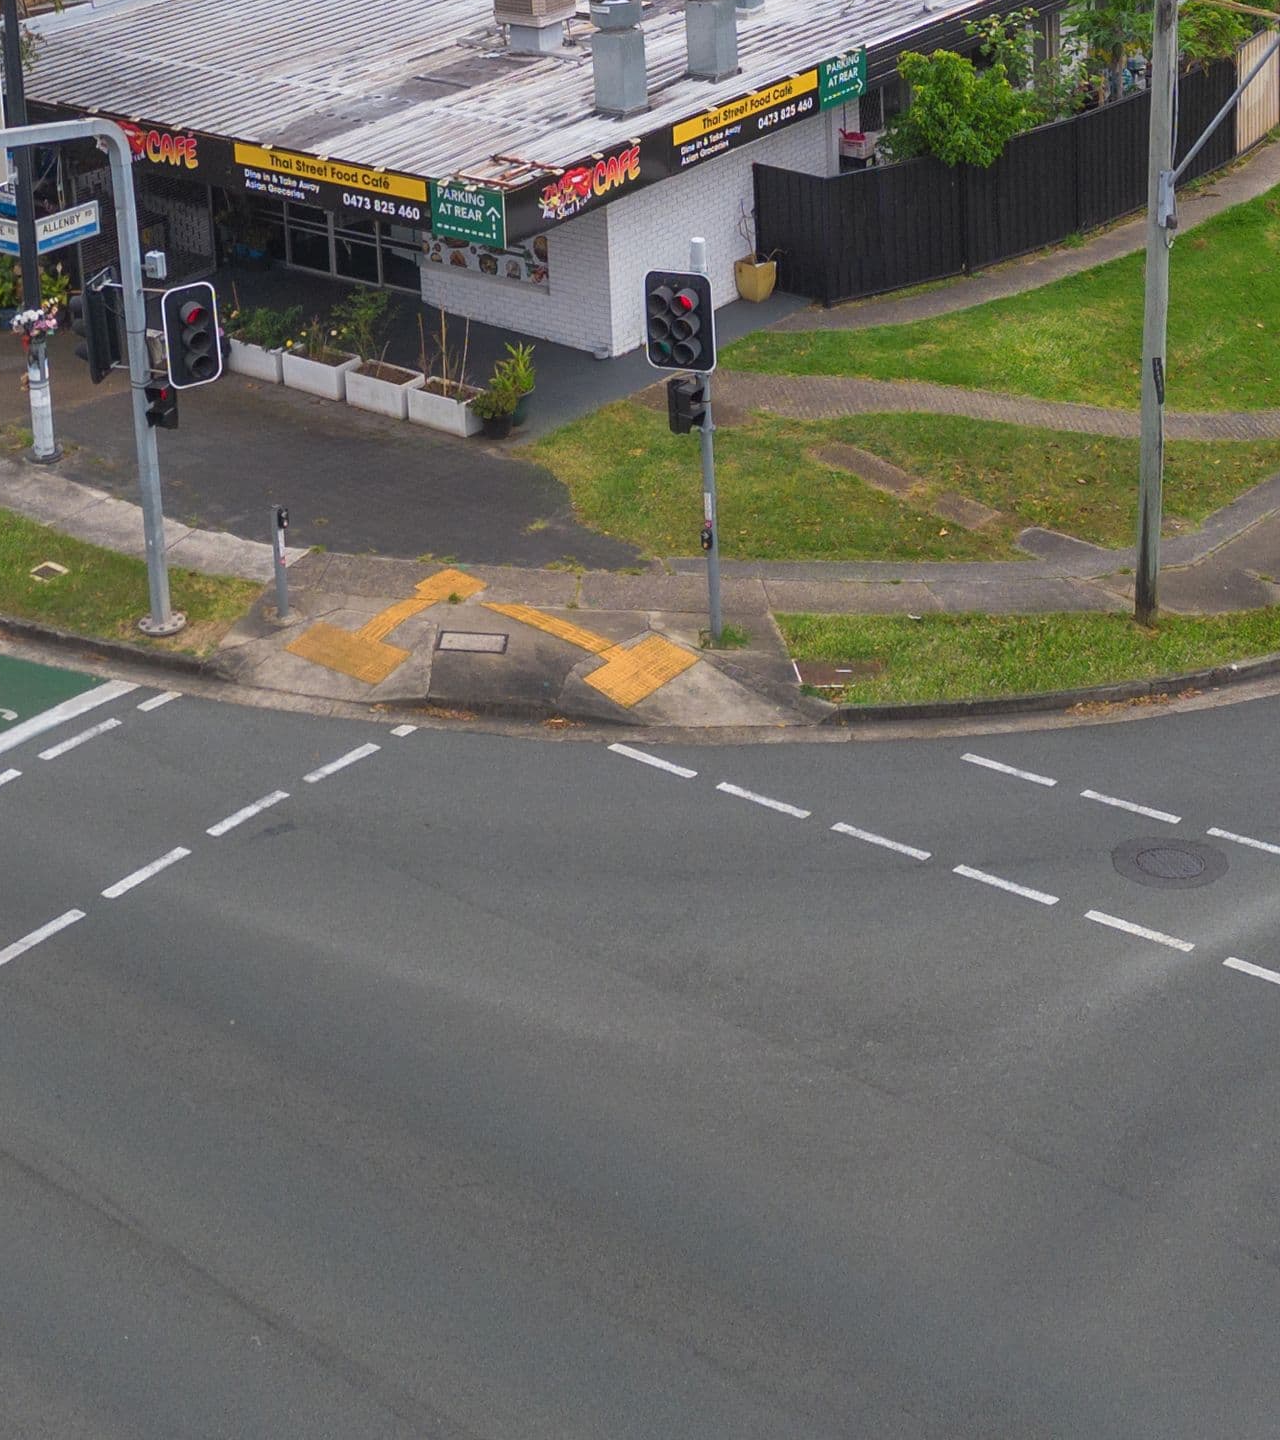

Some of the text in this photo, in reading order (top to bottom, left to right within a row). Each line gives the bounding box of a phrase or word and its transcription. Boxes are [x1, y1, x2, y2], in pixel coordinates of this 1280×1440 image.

[826, 53, 860, 75] PARKING
[828, 67, 859, 88] AT REAR
[702, 83, 793, 130] Thai Street Food Café
[758, 97, 813, 129] 0473 825 460
[146, 130, 199, 170] CAFÉ
[269, 154, 390, 189] Thai Street Food Café
[245, 179, 305, 199] Asian Groceries
[279, 175, 297, 187] Take
[299, 180, 320, 194] Away
[342, 193, 420, 220] 0473 825 460
[436, 186, 485, 207] PARKING
[438, 202, 483, 222] AT REAR
[42, 214, 81, 235] ALLENBY
